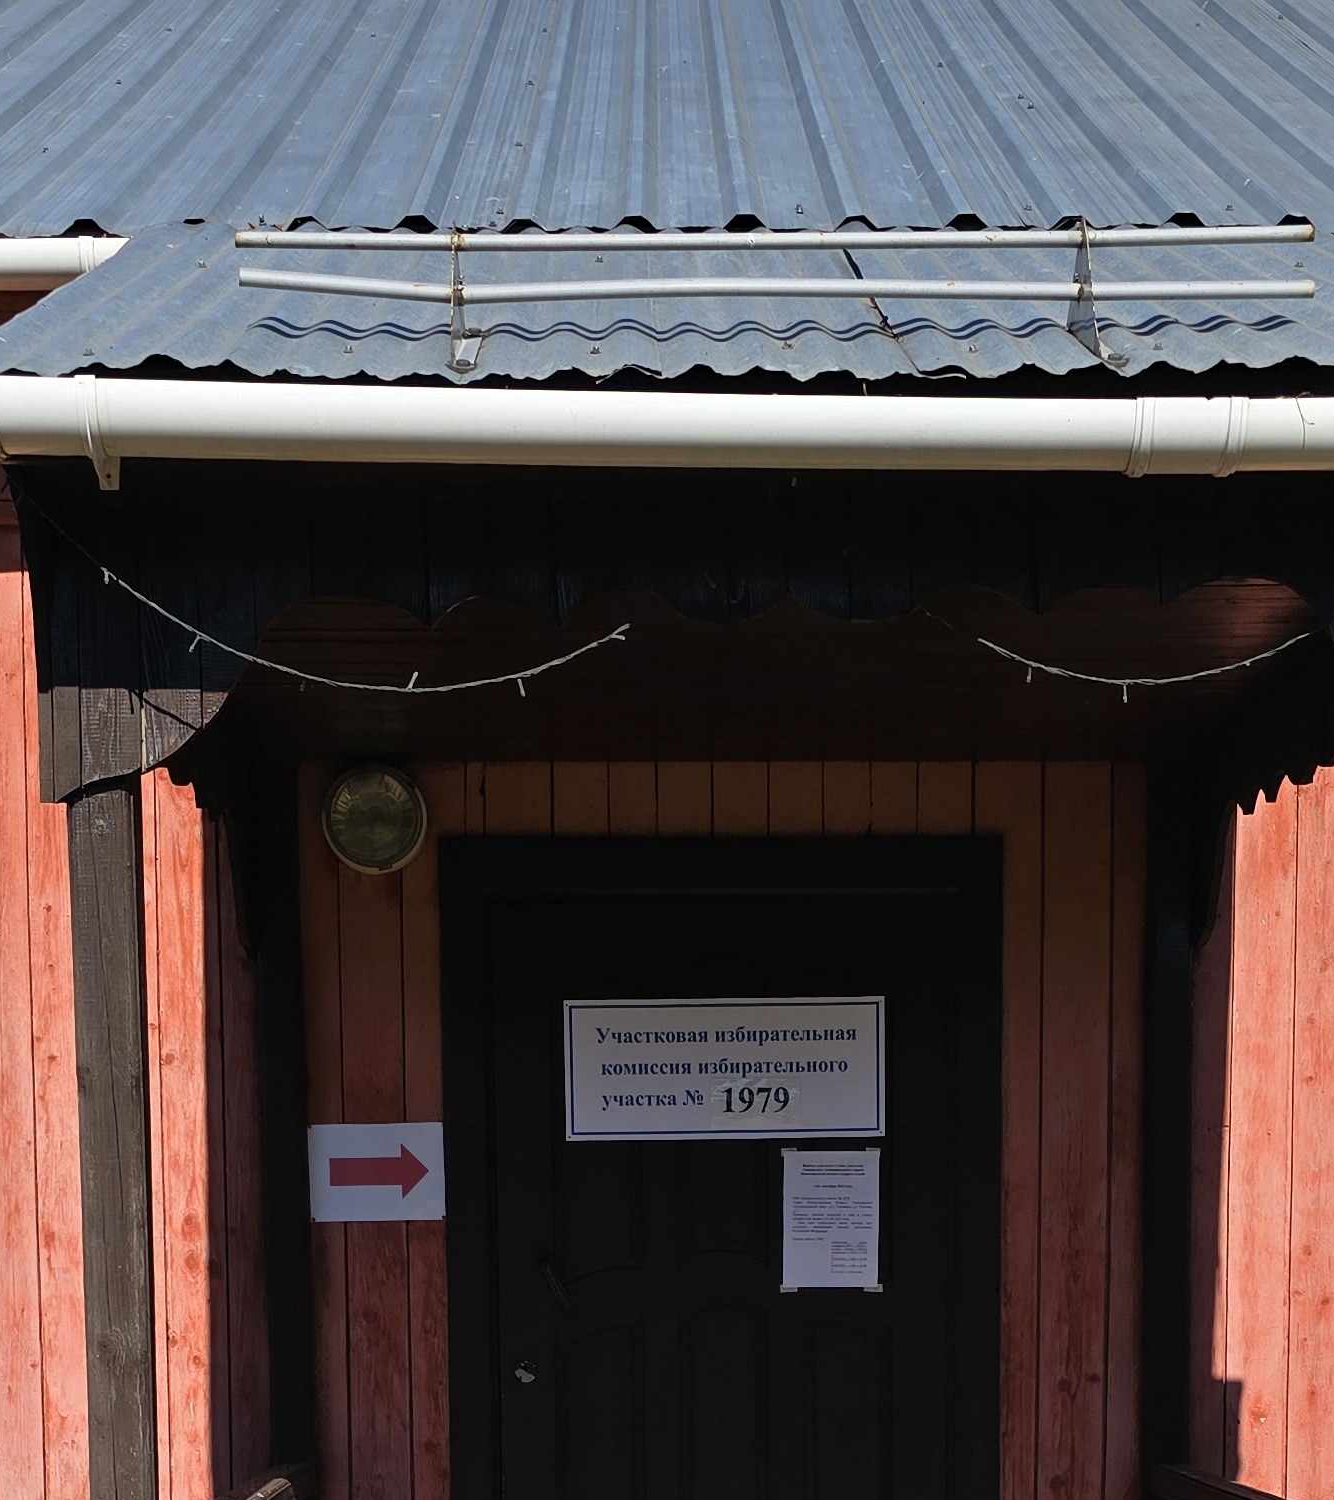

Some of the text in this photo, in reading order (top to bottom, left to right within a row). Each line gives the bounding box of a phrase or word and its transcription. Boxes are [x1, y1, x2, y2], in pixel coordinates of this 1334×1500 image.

[596, 1026, 857, 1046] Участковая избирательная
[601, 1058, 848, 1078] комиссия избирательного
[601, 1086, 790, 1113] участка № 1979
